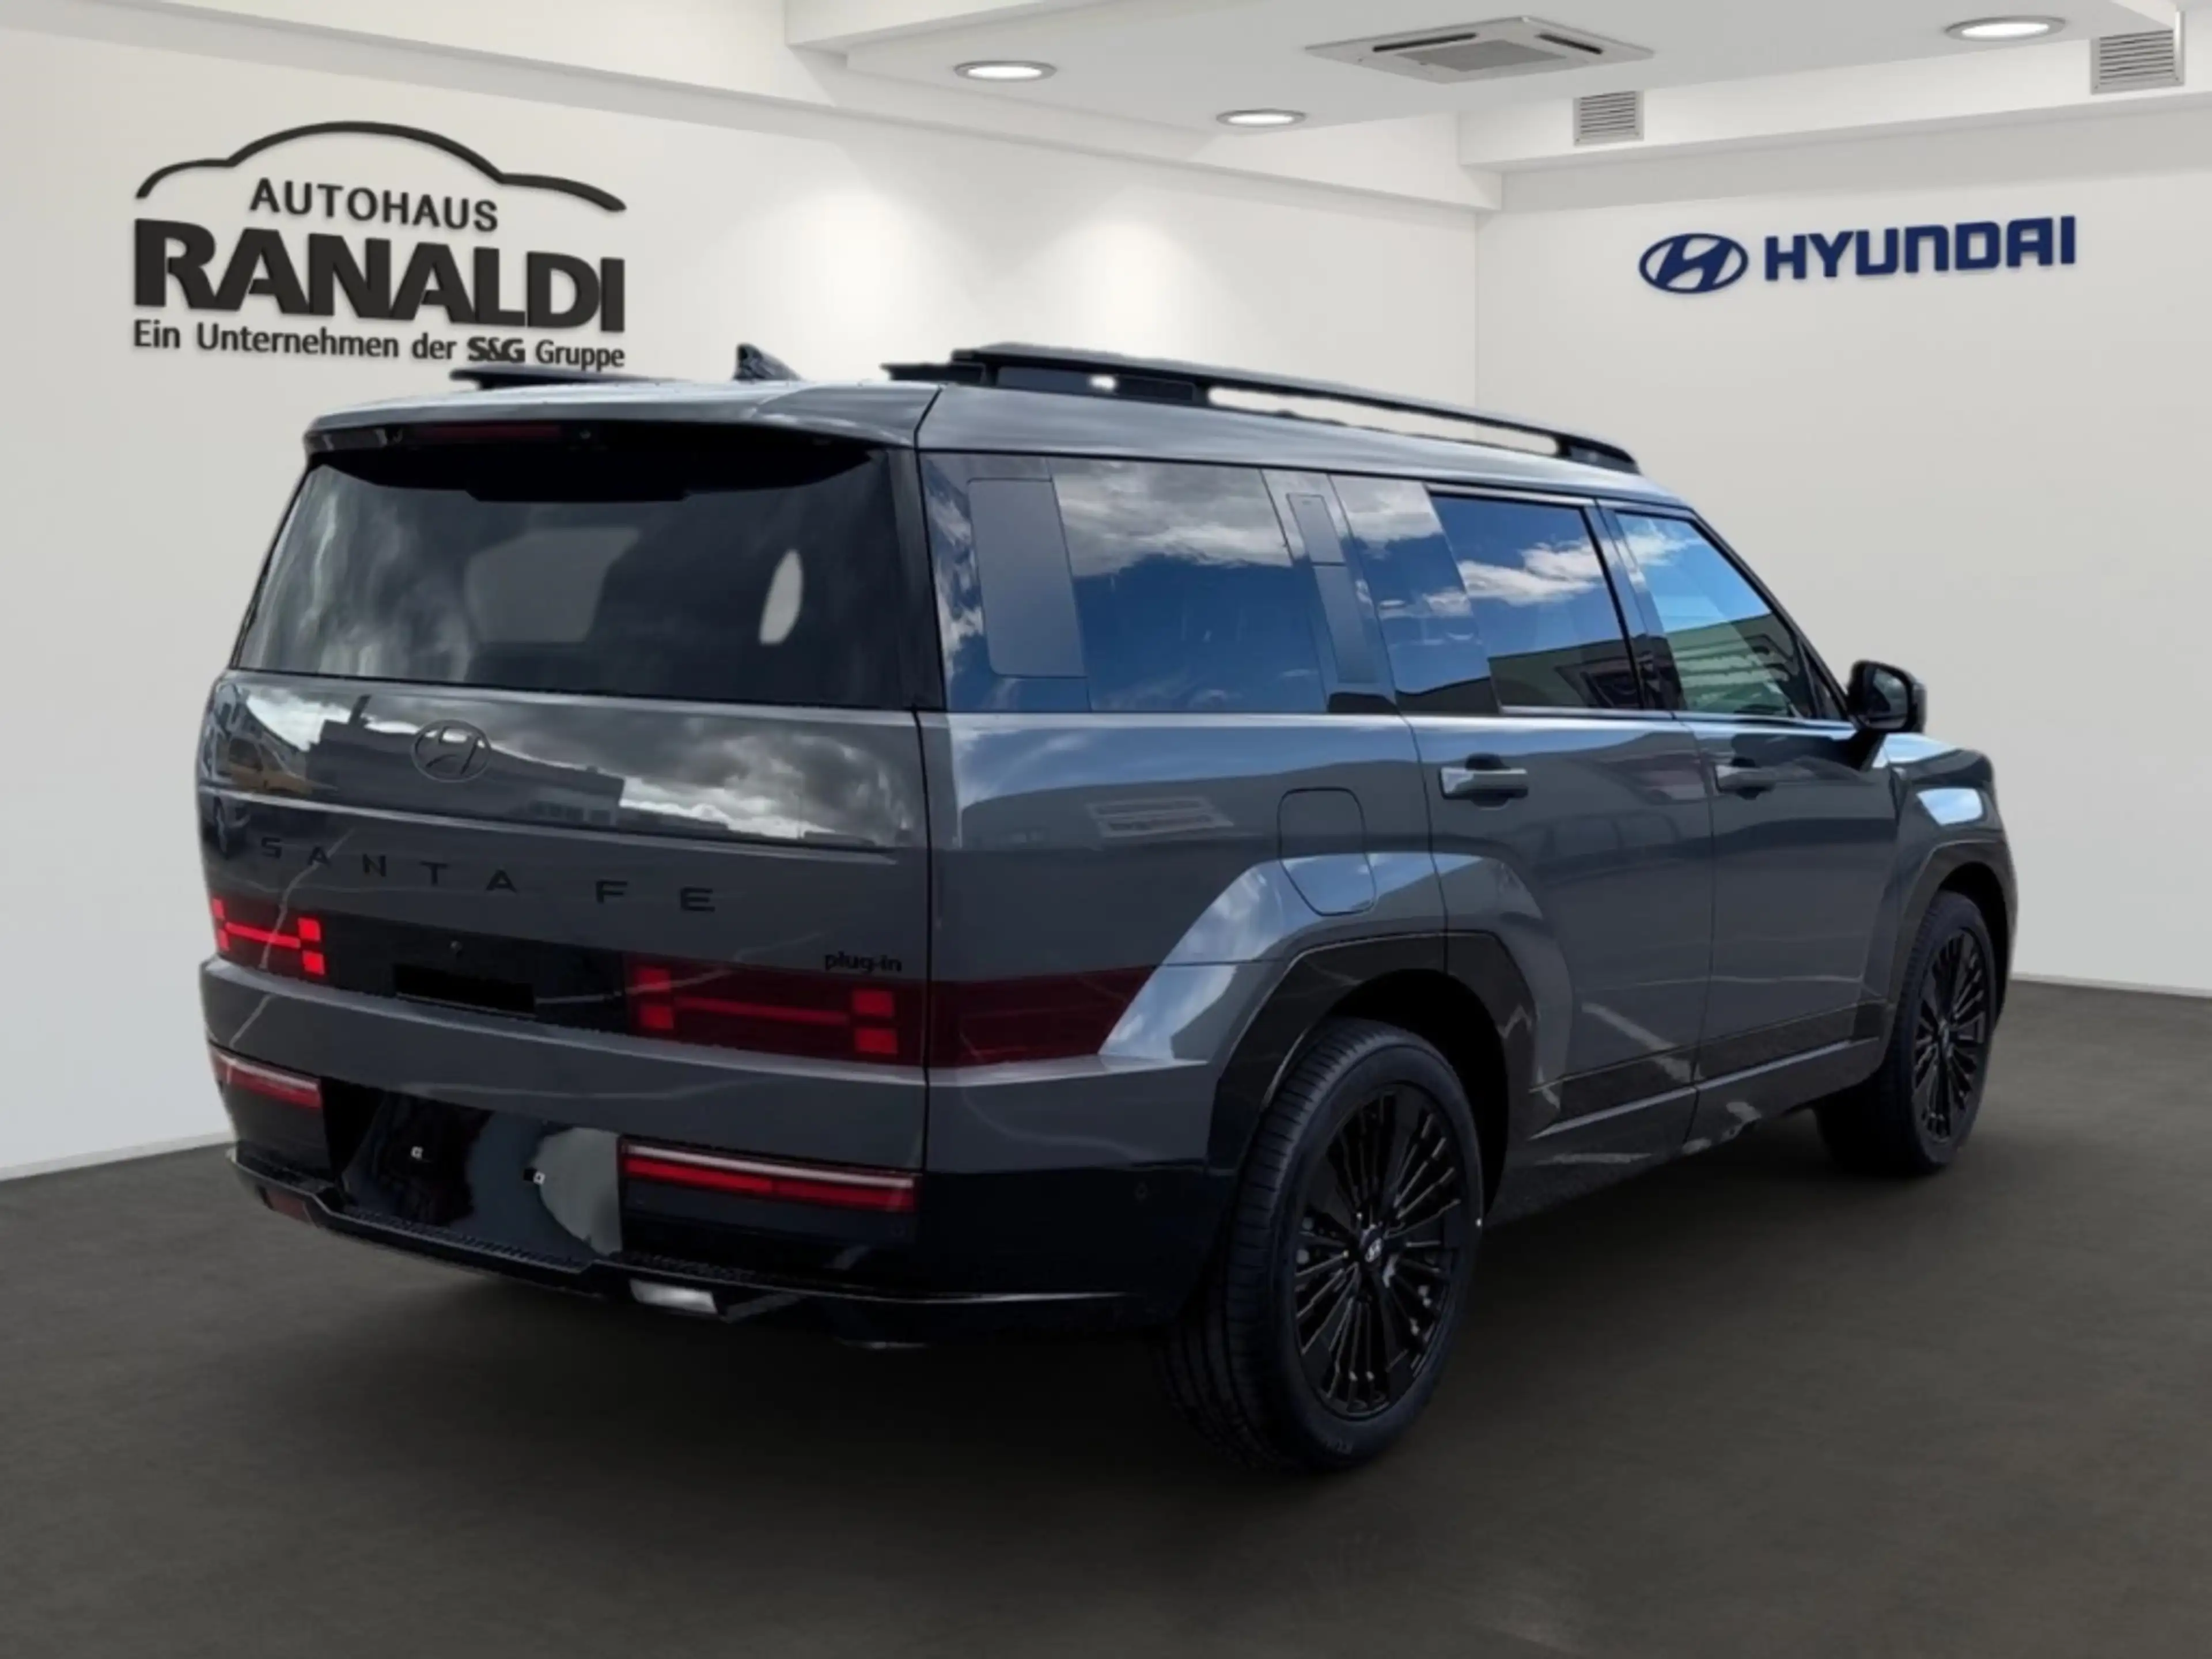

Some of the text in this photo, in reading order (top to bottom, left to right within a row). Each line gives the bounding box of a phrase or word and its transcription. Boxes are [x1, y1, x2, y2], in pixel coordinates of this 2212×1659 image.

[249, 178, 498, 232] AUTOHAUS
[134, 218, 624, 333] RANALDI
[1764, 215, 2076, 282] HYUNDAI
[134, 319, 625, 372] Ein Unternehmen der S&G Gruppe
[261, 836, 715, 912] SANTA FE
[825, 950, 902, 973] plug-in
